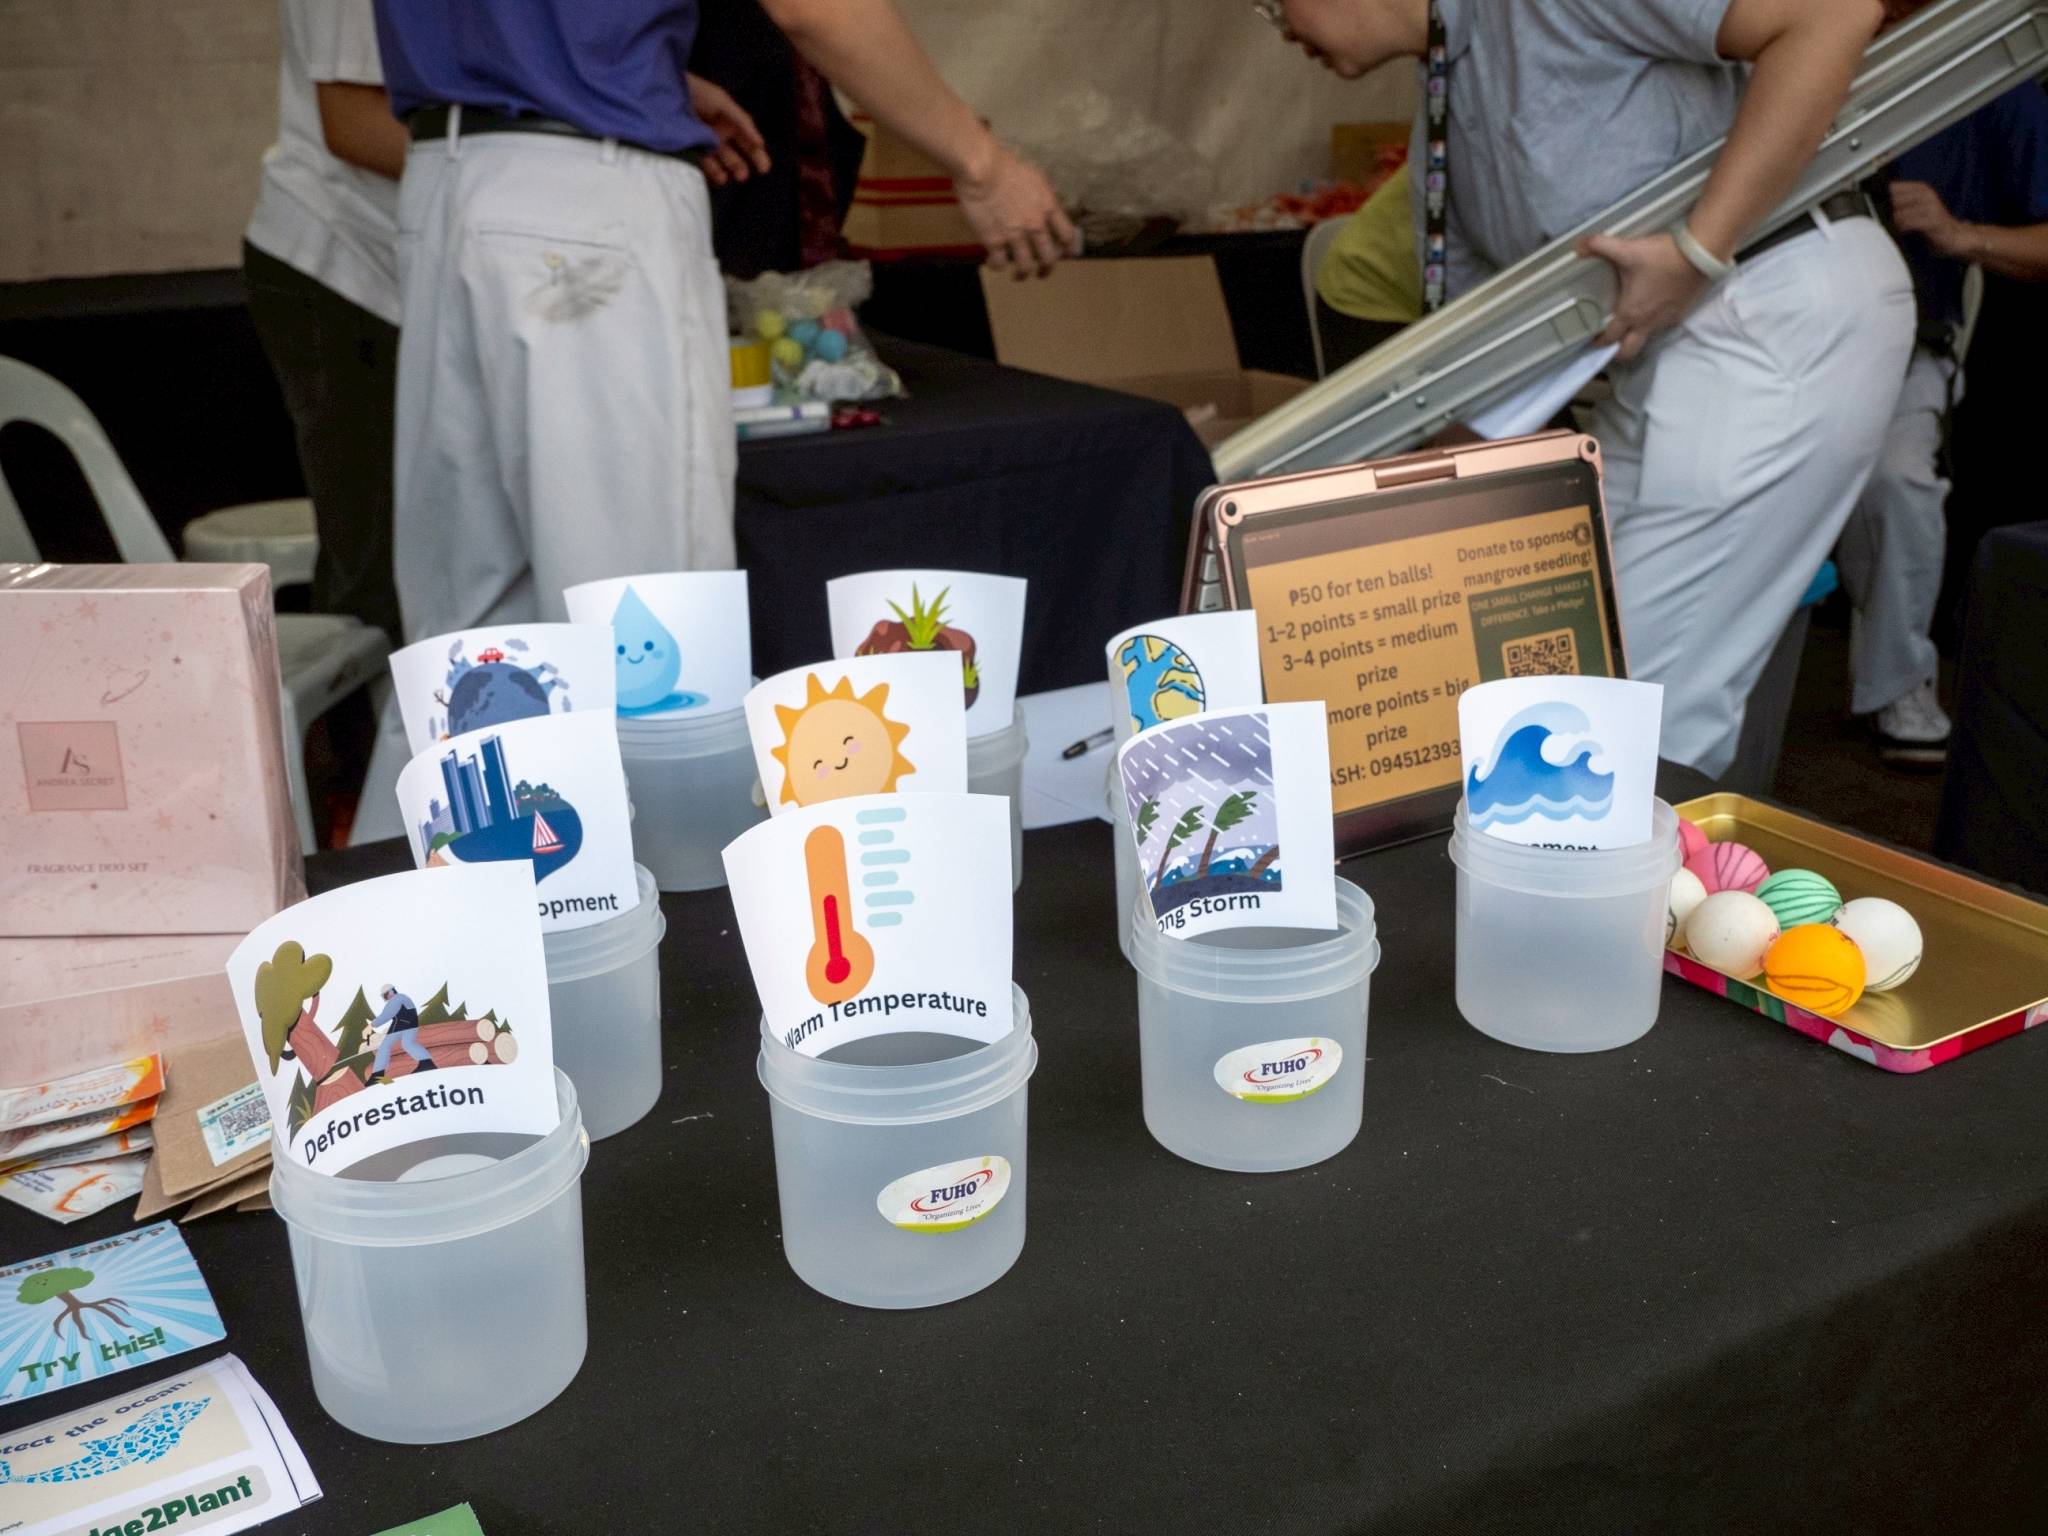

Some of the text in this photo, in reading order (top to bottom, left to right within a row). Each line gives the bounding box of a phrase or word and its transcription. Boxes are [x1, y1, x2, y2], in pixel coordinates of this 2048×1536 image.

[1457, 529, 1577, 562] Donate to sponso
[1327, 581, 1352, 598] for
[1356, 576, 1385, 593] ten
[1388, 563, 1433, 586] balls!
[1463, 548, 1592, 588] mangrove seedling!
[1301, 611, 1355, 640] points
[1360, 610, 1368, 620] =
[1373, 597, 1418, 621] small
[1421, 590, 1462, 615] prize
[1319, 639, 1374, 668] points
[1378, 638, 1386, 647] =
[1391, 621, 1459, 648] medium
[1356, 665, 1398, 691] prize
[1328, 703, 1372, 725] more
[1376, 689, 1429, 718] points
[1433, 687, 1441, 696] =
[1366, 725, 1408, 751] prize
[27, 861, 150, 875] FRAGRANCE DUO SET
[1190, 894, 1260, 918] Storm
[784, 991, 987, 1050] Warm Temperature
[304, 1084, 484, 1165] Deforestation
[100, 1326, 167, 1361] this!
[65, 1416, 108, 1438] the
[115, 1381, 193, 1414] ocean.
[89, 1475, 252, 1536] e2Plant
